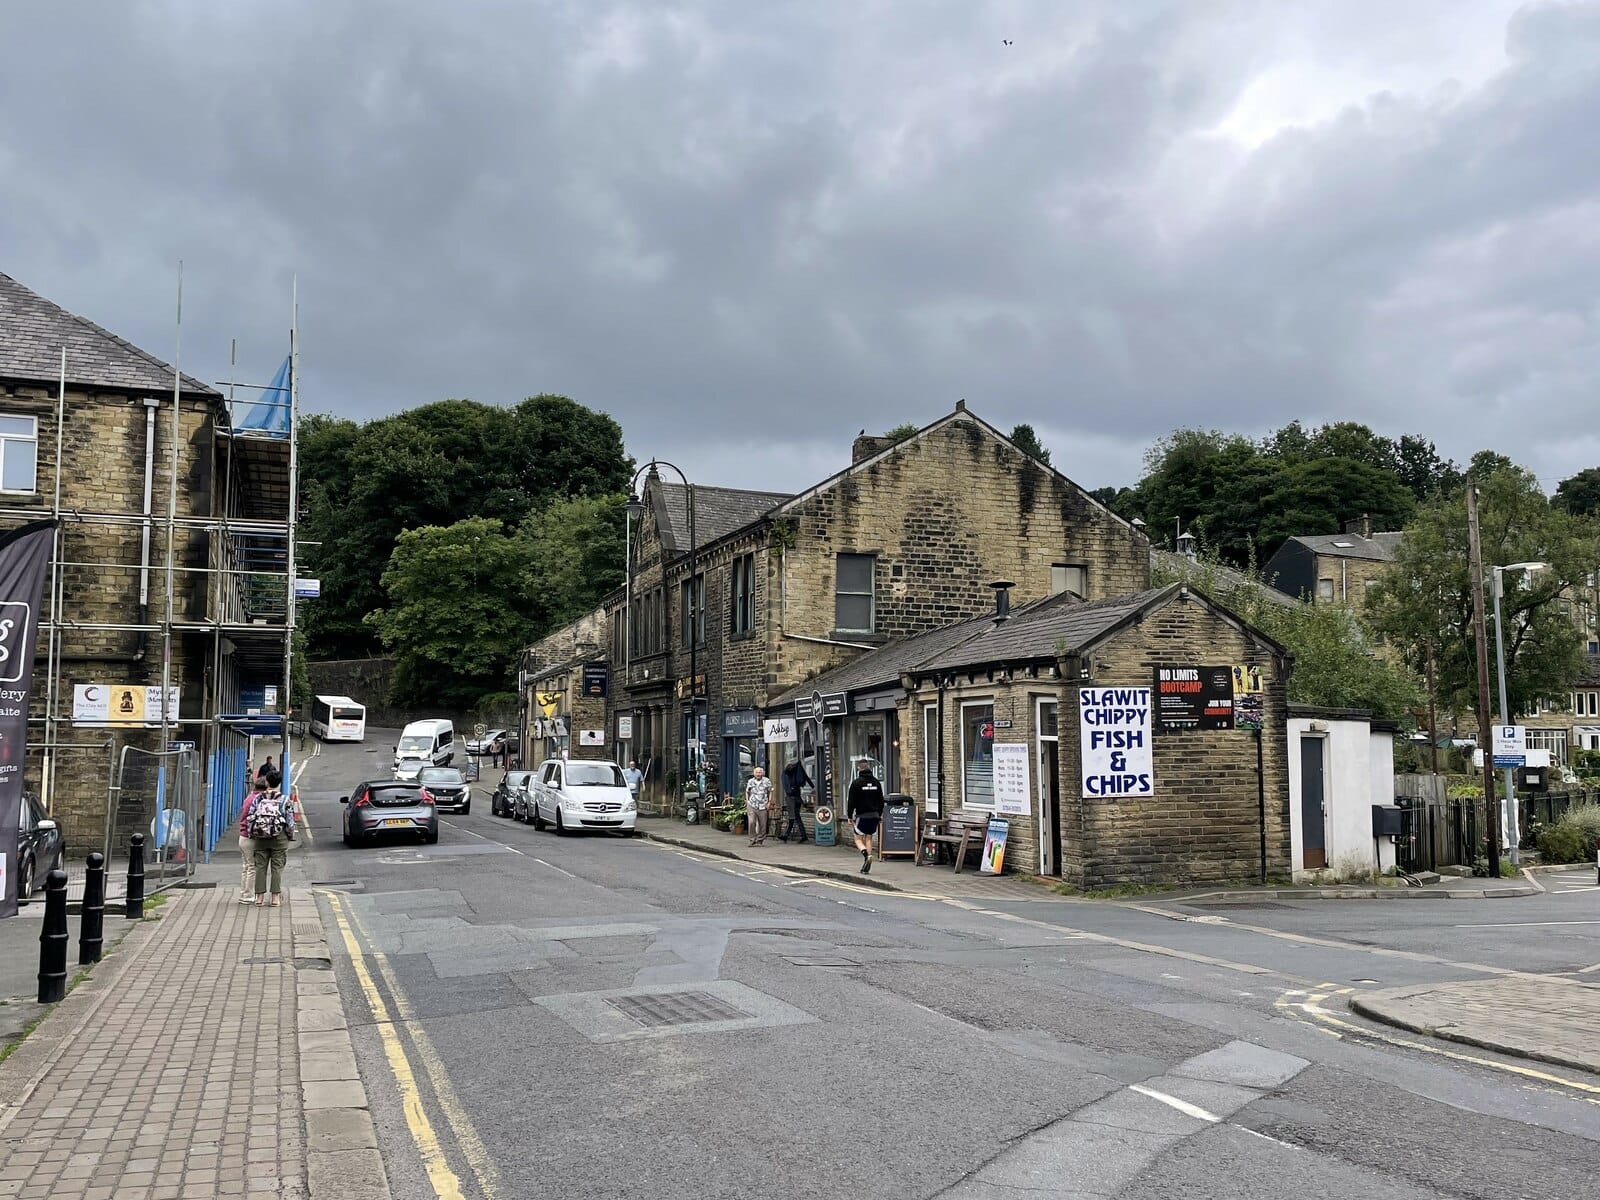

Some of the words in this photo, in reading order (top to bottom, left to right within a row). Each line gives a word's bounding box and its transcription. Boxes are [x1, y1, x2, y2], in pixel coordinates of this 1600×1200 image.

[1159, 669, 1171, 681] NO
[1172, 669, 1199, 681] LIMITS
[1160, 681, 1202, 693] BOOTCAMP
[1080, 690, 1150, 707] SLAWIT
[1084, 708, 1148, 726] CHIPPY
[1091, 730, 1143, 750] FISH
[1504, 728, 1513, 738] P
[1110, 751, 1126, 772] &
[1086, 774, 1150, 796] CHIPS
